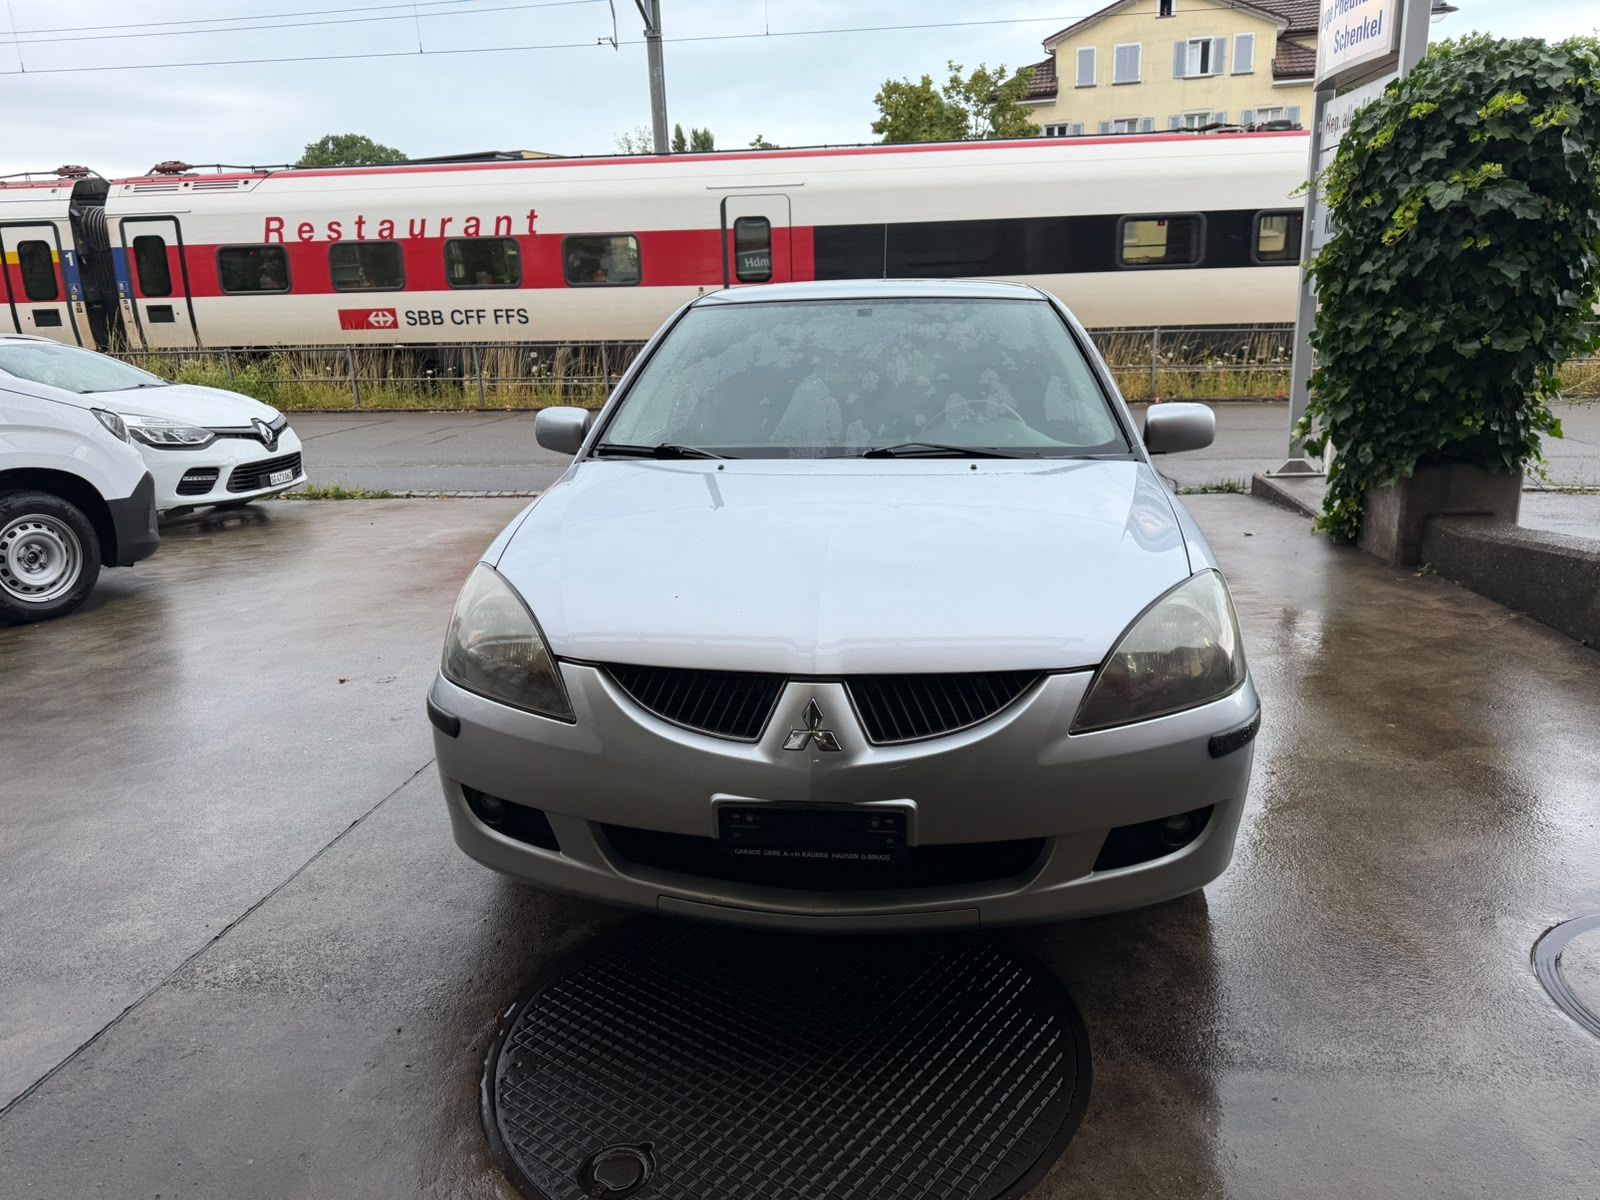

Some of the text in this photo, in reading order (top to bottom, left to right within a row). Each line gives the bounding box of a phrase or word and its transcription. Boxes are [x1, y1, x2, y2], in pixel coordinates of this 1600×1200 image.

[1333, 9, 1383, 54] Schenkel
[1326, 112, 1341, 137] Rep.
[263, 208, 539, 244] Restaurant
[65, 251, 74, 267] 1
[405, 307, 530, 326] SBB CFF FFS
[734, 848, 761, 856] GARAGE
[831, 852, 859, 860] HAUSEN
